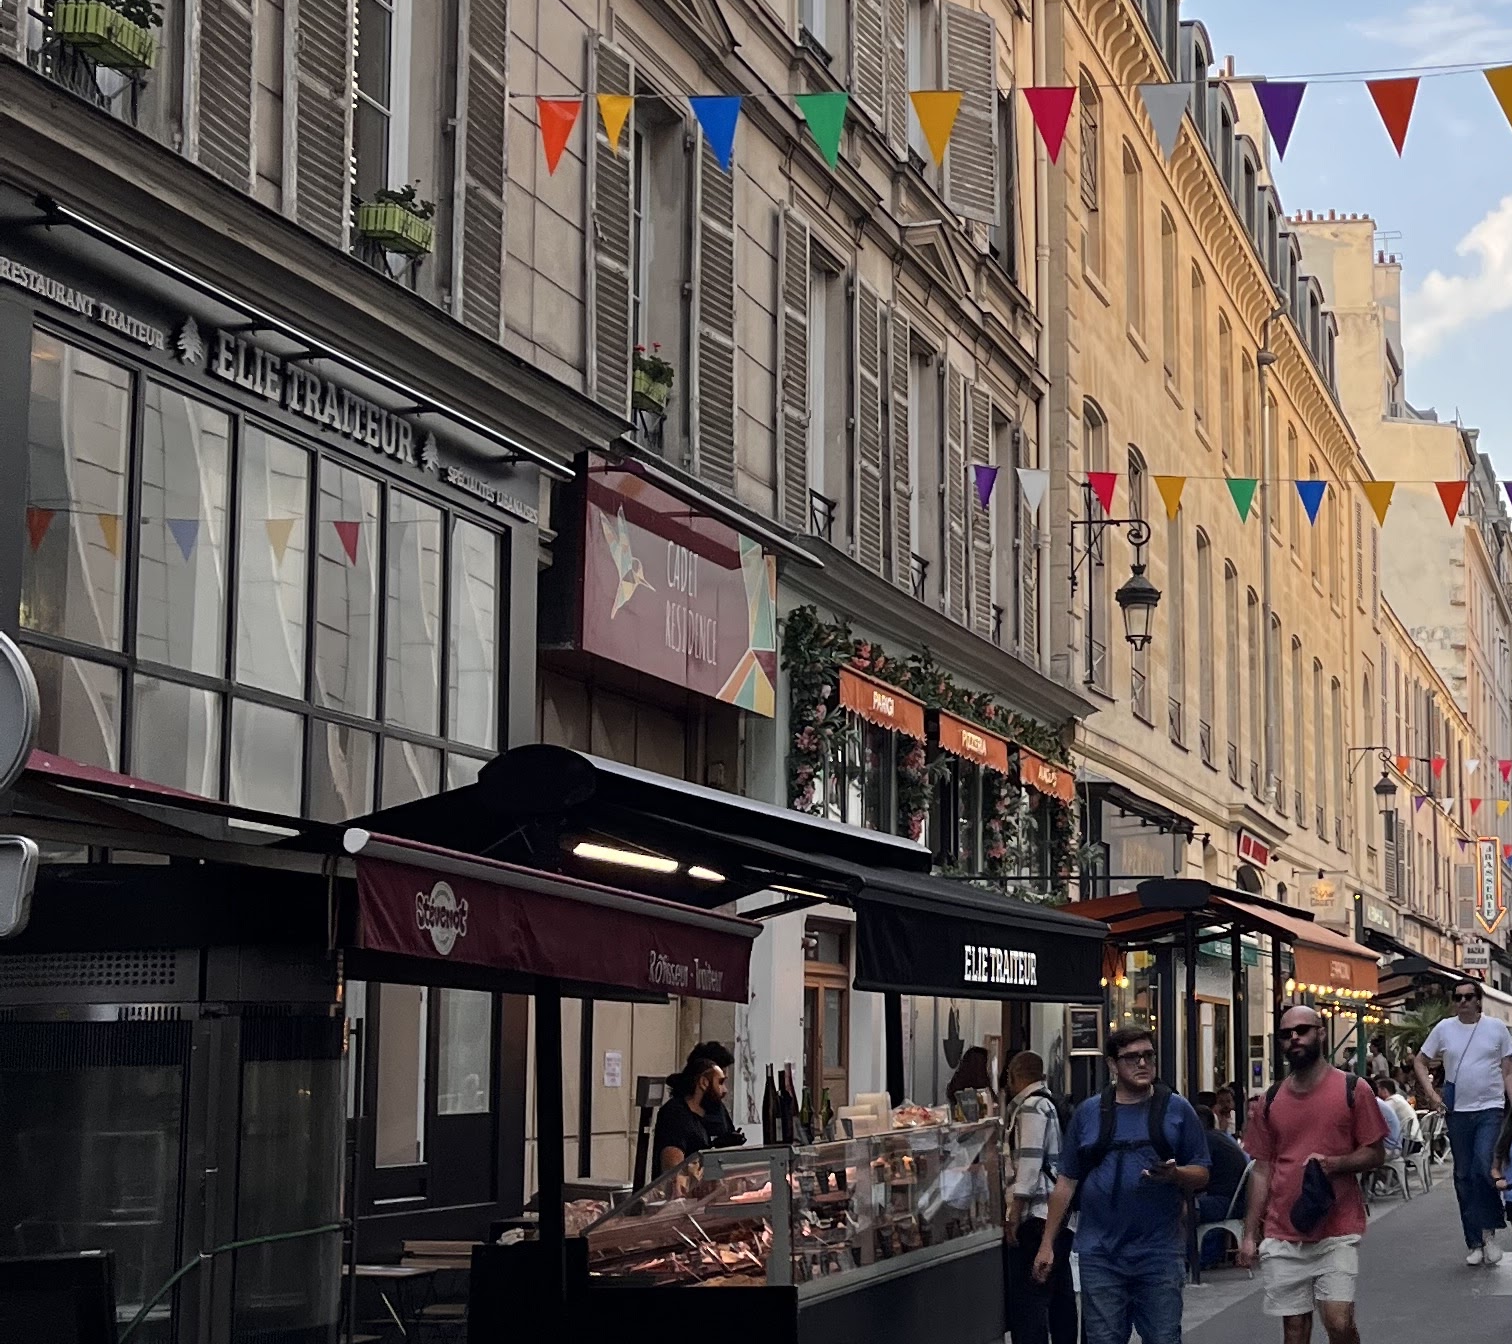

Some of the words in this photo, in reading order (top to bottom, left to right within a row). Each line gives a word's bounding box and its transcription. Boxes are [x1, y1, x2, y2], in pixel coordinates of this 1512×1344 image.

[0, 257, 96, 318] RESTAURANT
[98, 302, 165, 351] TRAITEUR
[215, 328, 281, 402] ELIE
[286, 361, 414, 464] TRAITEUR
[667, 540, 699, 598] CADET
[665, 600, 717, 666] RESIDENCE
[964, 945, 988, 982] ELIE
[989, 947, 1038, 986] TRAITEUR
